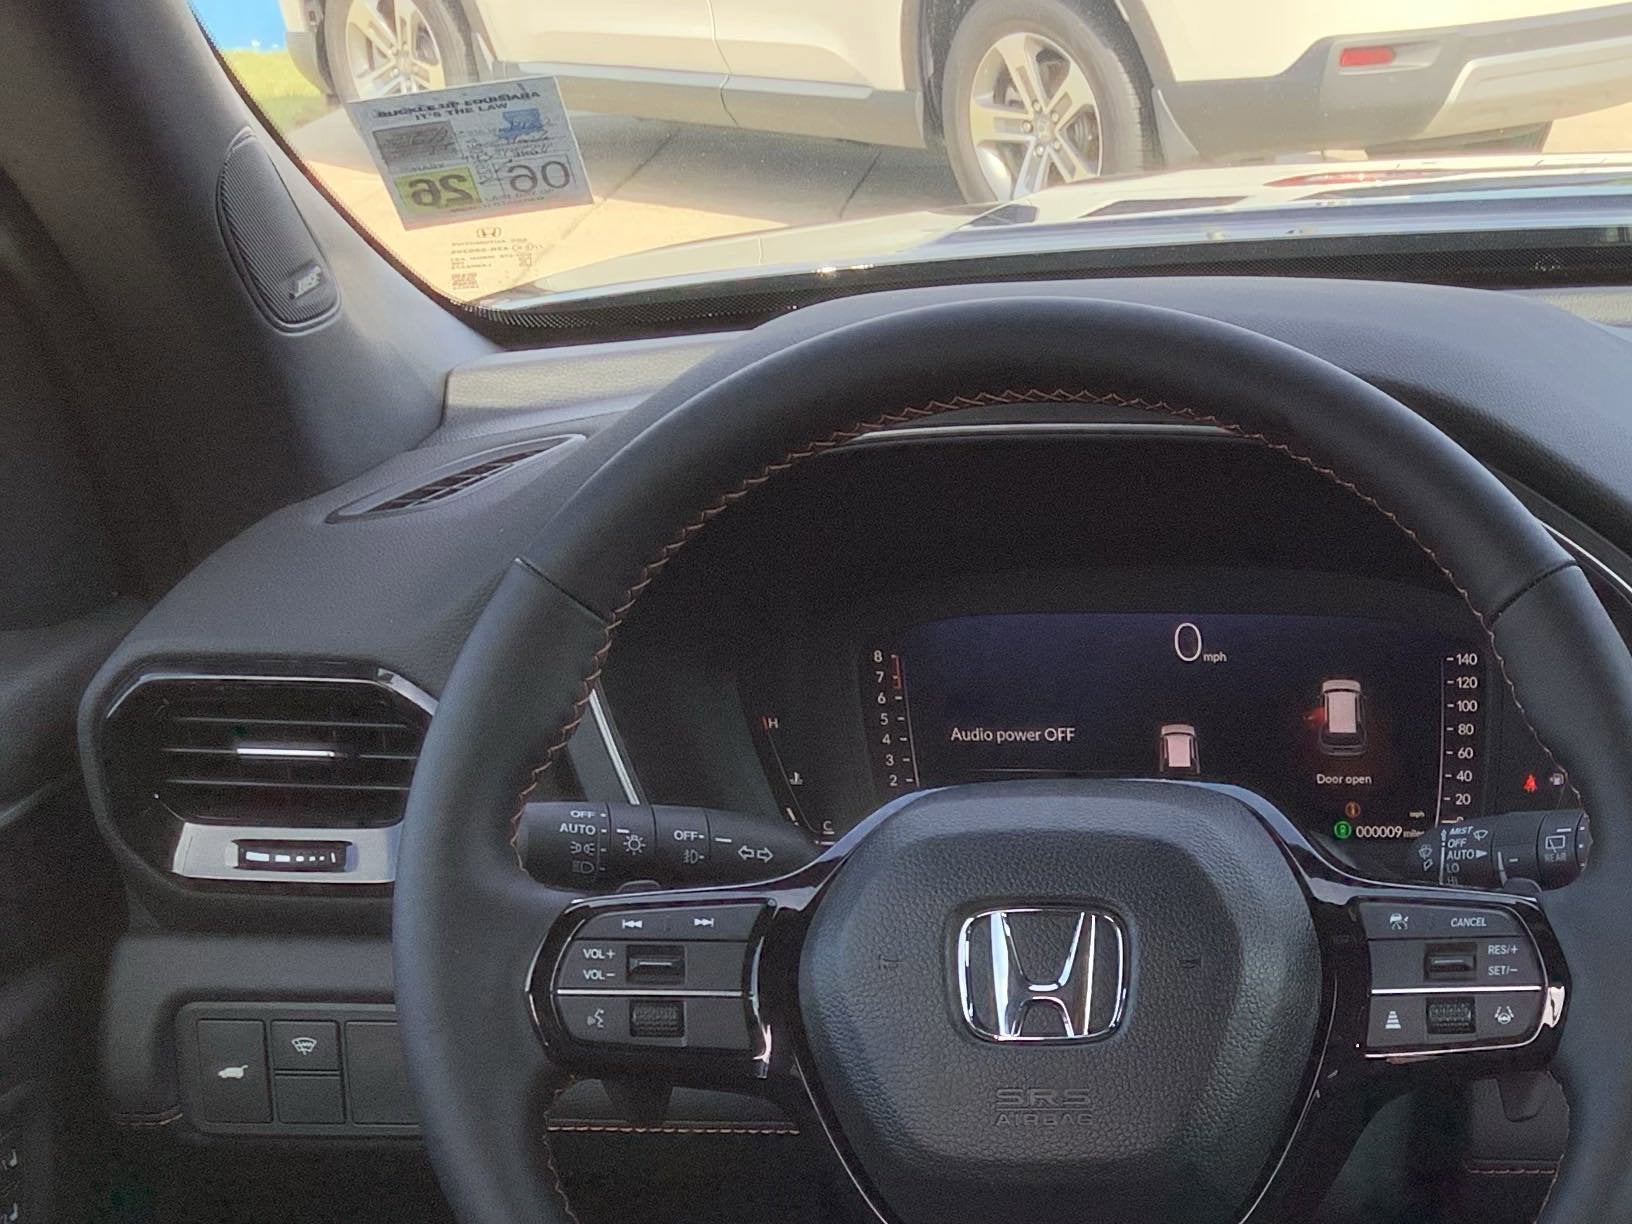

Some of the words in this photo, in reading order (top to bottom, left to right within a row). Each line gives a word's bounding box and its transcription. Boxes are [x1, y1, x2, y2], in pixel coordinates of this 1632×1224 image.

[446, 107, 473, 116] THE
[478, 102, 508, 113] LAW
[1174, 622, 1202, 662] 0
[1203, 651, 1227, 664] mph
[873, 650, 883, 663] 8
[1456, 653, 1478, 665] 140
[876, 671, 884, 683] 7
[1456, 676, 1478, 688] 120
[877, 692, 886, 704] 6
[1456, 700, 1478, 712] 100
[768, 718, 779, 729] H
[880, 713, 889, 725] 5
[1458, 723, 1474, 735] 80
[882, 734, 891, 744] 4
[950, 727, 993, 742] Audio
[997, 728, 1041, 744] power
[1044, 727, 1075, 742] OFF
[1457, 747, 1474, 759] 60
[885, 754, 894, 766] 3
[889, 774, 898, 786] 2
[1316, 774, 1343, 785] Door
[1345, 774, 1372, 786] open
[1456, 770, 1473, 782] 40
[1455, 793, 1471, 805] 20
[570, 810, 595, 818] OFF
[559, 823, 596, 836] AUTO
[823, 820, 833, 831] C
[1449, 825, 1475, 836] MIST
[673, 830, 698, 842] OFF
[1355, 826, 1403, 838] 000009
[1447, 838, 1467, 848] OFF
[1446, 849, 1474, 861] AUTO
[1545, 852, 1567, 862] REAR
[1446, 863, 1460, 873] LO
[1450, 917, 1487, 927] CANCEL
[996, 1088, 1092, 1107] SRS
[996, 1113, 1094, 1127] AIRBAG
